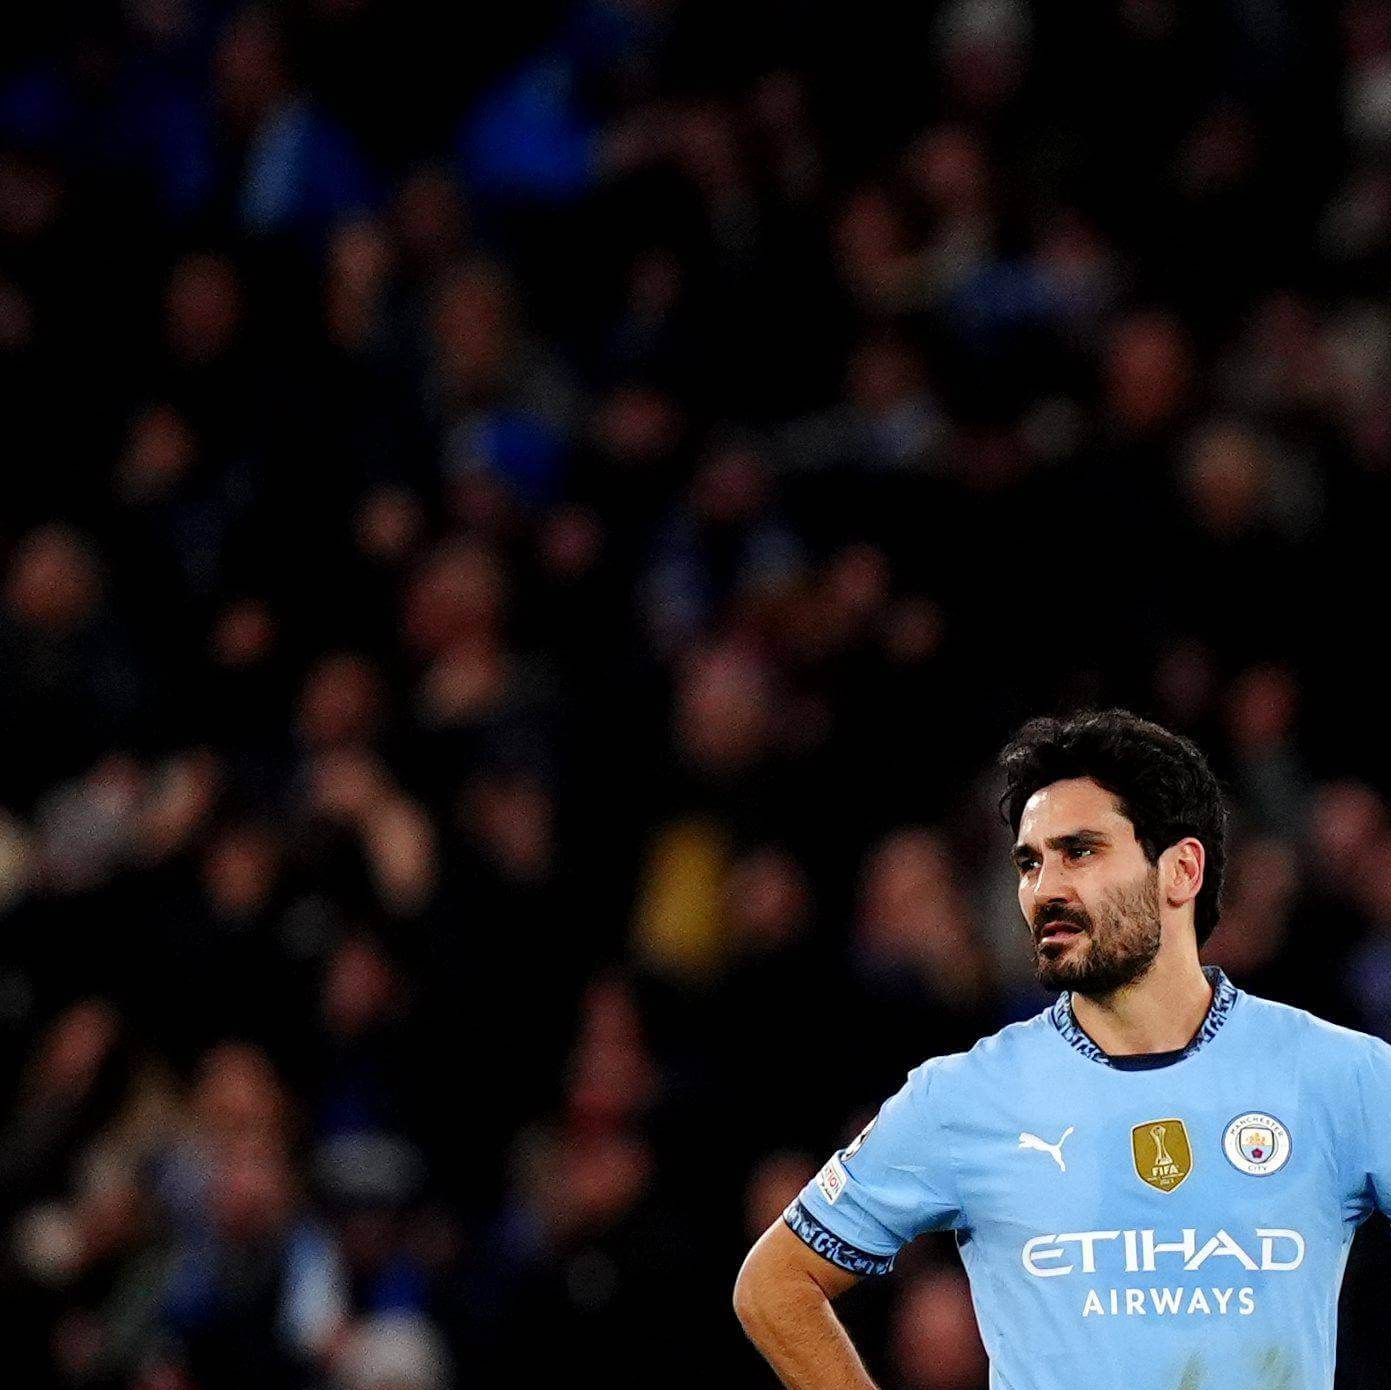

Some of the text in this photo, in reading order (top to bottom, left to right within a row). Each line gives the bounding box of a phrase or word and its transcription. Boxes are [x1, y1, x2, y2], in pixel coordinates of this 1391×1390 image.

[1152, 1164, 1179, 1177] FIFA
[1021, 1228, 1306, 1277] ETIHAD
[1082, 1286, 1256, 1317] AIRWAYS
